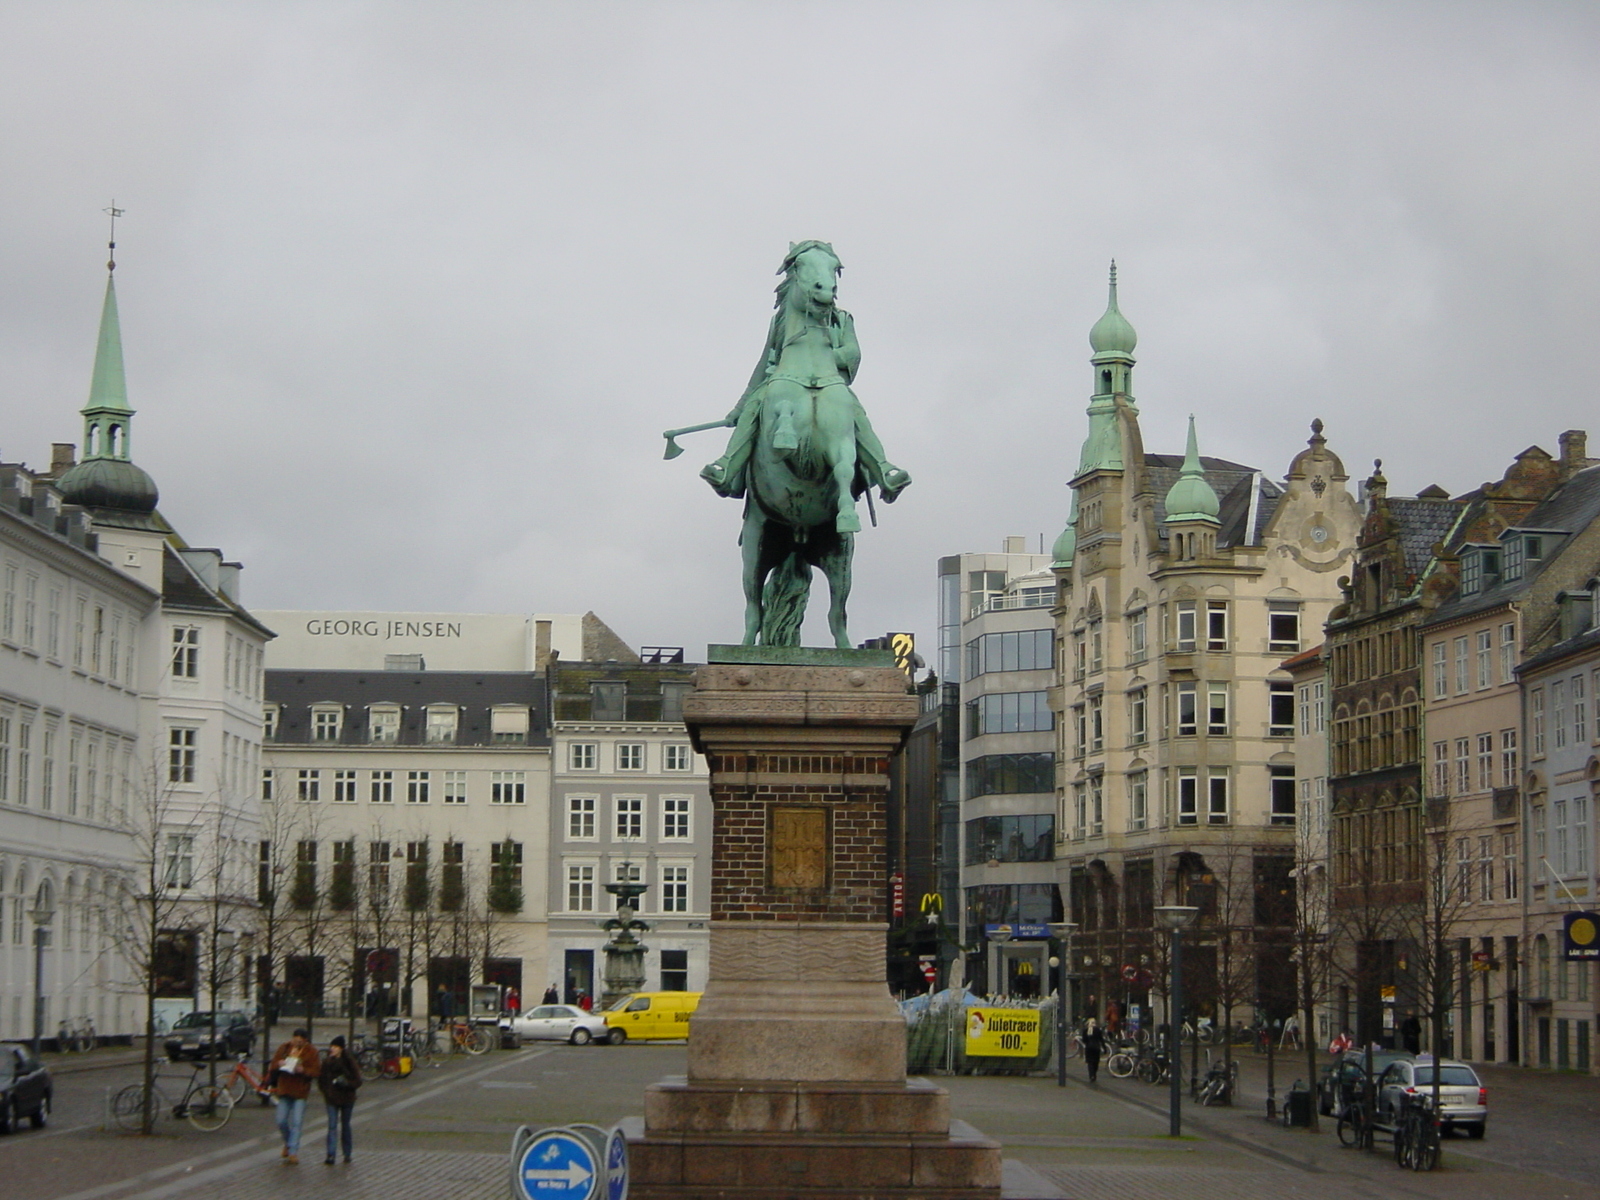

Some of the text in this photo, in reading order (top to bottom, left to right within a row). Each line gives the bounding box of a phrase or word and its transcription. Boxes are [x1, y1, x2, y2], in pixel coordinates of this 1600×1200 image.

[306, 619, 462, 640] GEORG JENSEN
[987, 1017, 1038, 1033] Juletræer
[999, 1033, 1028, 1051] 100,-
